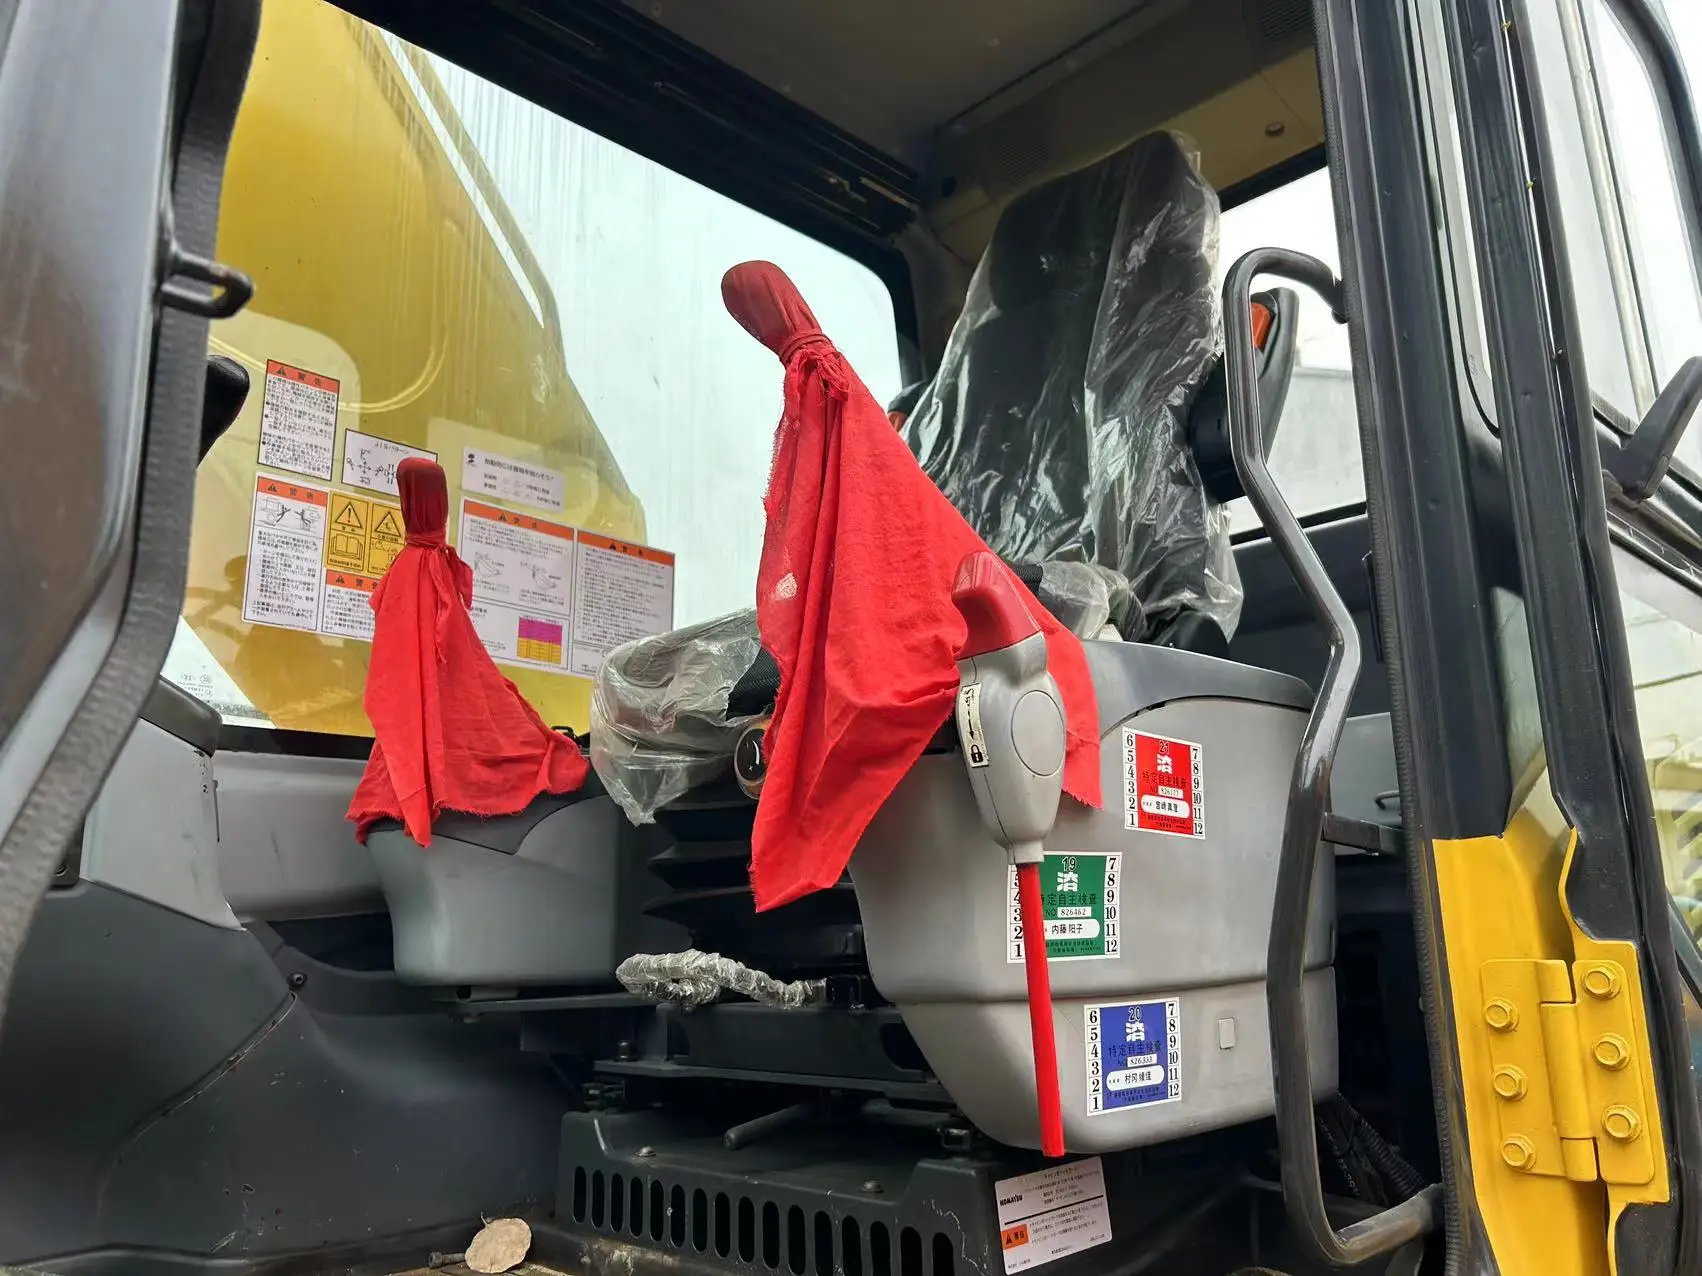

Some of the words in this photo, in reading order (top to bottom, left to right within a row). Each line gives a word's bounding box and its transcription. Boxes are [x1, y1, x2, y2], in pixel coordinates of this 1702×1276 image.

[1126, 734, 1134, 747] 6
[1159, 740, 1170, 754] 21
[1127, 750, 1134, 762] 5
[1192, 748, 1198, 760] 7
[1127, 765, 1134, 779] 4
[1193, 762, 1199, 775] 8
[1128, 781, 1135, 793] 3
[1194, 777, 1200, 790] 9
[1128, 797, 1136, 809] 2
[1193, 792, 1202, 805] 10
[1130, 813, 1136, 826] 1
[1194, 807, 1202, 819] 11
[1194, 822, 1203, 834] 12
[1062, 856, 1076, 871] 19
[1109, 858, 1116, 870] 7
[1108, 874, 1115, 886] 8
[1107, 890, 1115, 903] 9
[1014, 908, 1022, 922] 3
[1060, 908, 1086, 916] 826462
[1105, 906, 1116, 920] 10
[1014, 926, 1023, 940] 2
[1106, 924, 1116, 936] 11
[1014, 944, 1022, 957] 1
[1106, 940, 1117, 952] 12
[1128, 1006, 1142, 1022] 20
[1168, 1003, 1175, 1016] 7
[1090, 1010, 1098, 1024] 6
[1169, 1019, 1176, 1032] 8
[1090, 1027, 1098, 1041] 5
[1169, 1035, 1176, 1048] 9
[1091, 1044, 1098, 1058] 4
[1168, 1051, 1178, 1064] 10
[1092, 1061, 1099, 1076] 3
[1169, 1068, 1178, 1080] 11
[1092, 1079, 1100, 1093] 2
[1169, 1084, 1179, 1096] 12
[1093, 1097, 1099, 1110] 1
[999, 1194, 1023, 1207] KOMATSU
